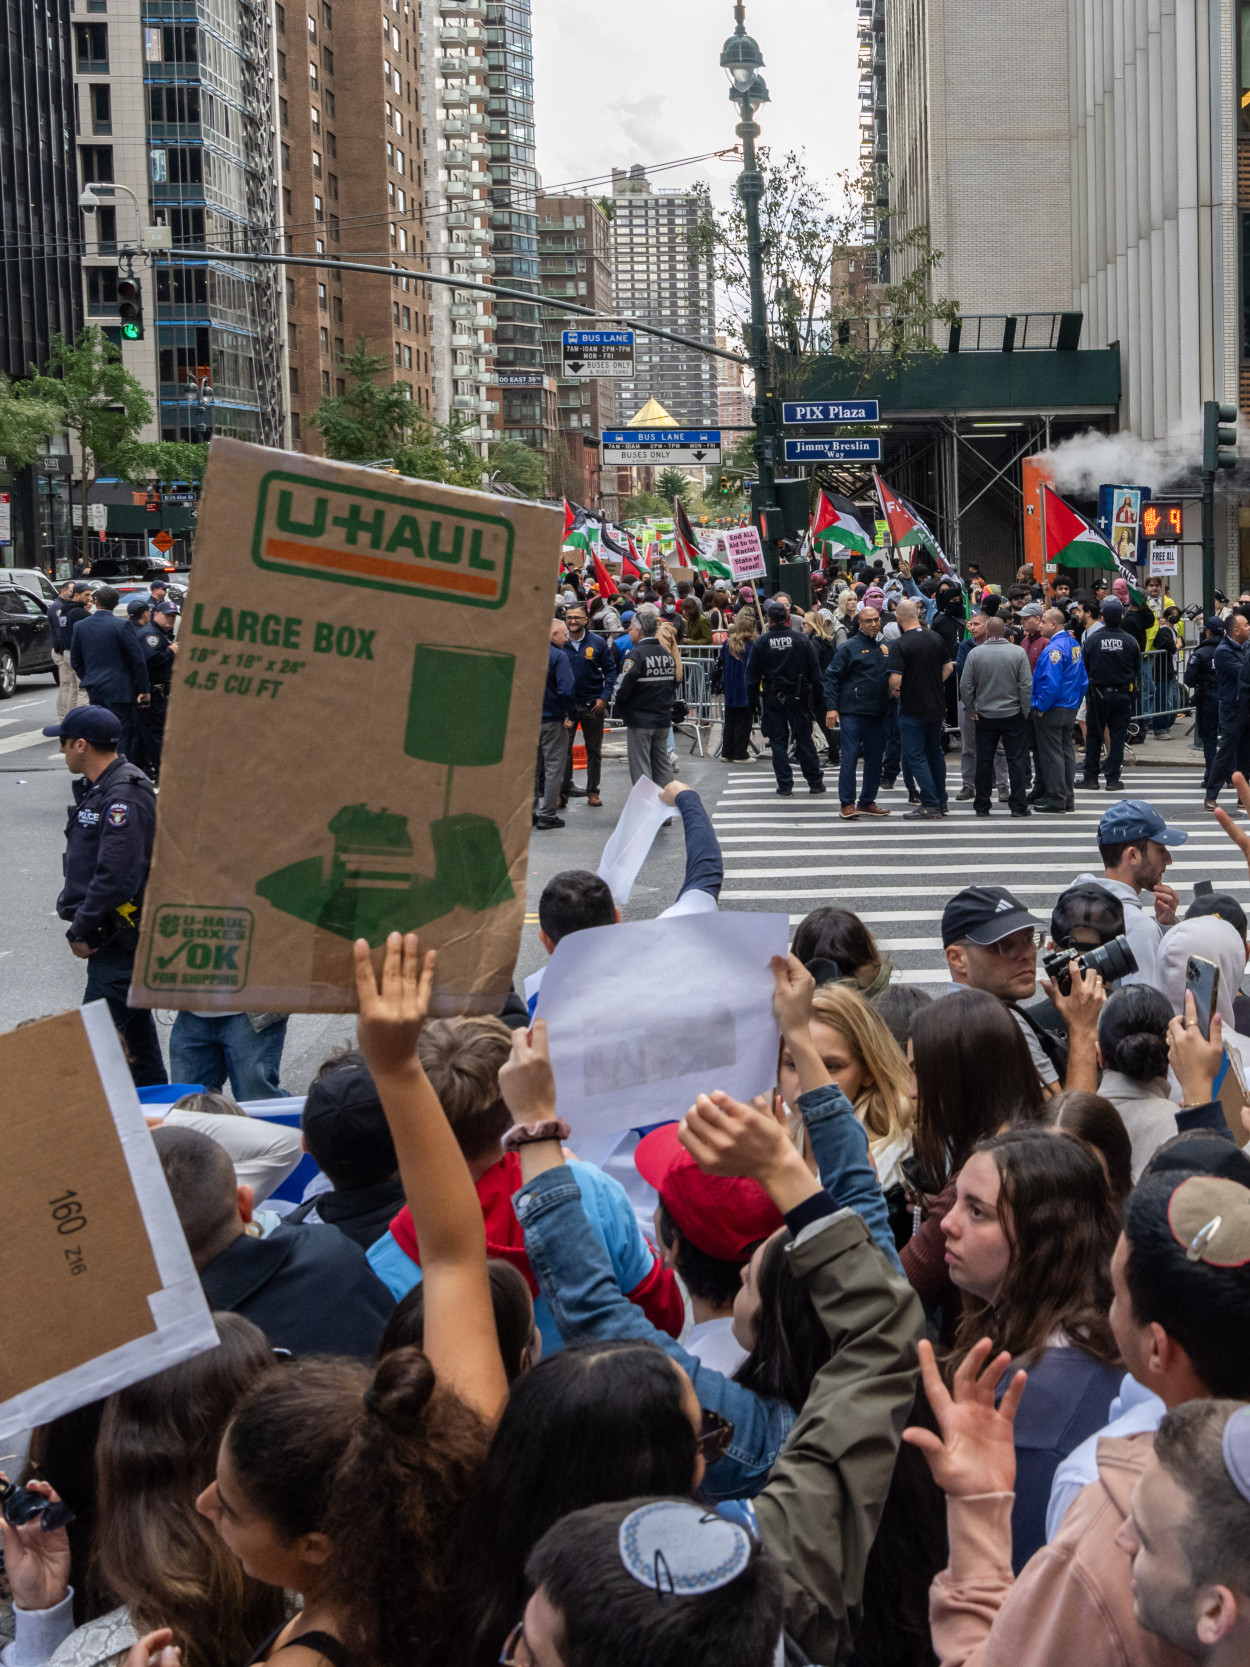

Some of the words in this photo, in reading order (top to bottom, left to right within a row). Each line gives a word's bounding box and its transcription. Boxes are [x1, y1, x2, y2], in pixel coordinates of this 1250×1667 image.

[582, 334, 601, 342] BUS
[603, 334, 629, 342] LANE
[586, 361, 610, 369] BUSES
[612, 361, 631, 369] ONLY
[795, 406, 824, 420] PIX
[828, 405, 866, 419] Plaza
[638, 433, 656, 441] BUS
[661, 433, 686, 441] LANE
[795, 442, 830, 453] Jimmy
[832, 441, 870, 451] Breslin
[621, 451, 648, 459] BUSES
[650, 451, 671, 459] ONLY
[827, 451, 845, 459] Way
[1169, 508, 1180, 534] 9
[275, 489, 497, 572] U-HAUL
[729, 533, 742, 541] End
[735, 546, 756, 555] Racist
[734, 557, 753, 565] State
[1152, 552, 1166, 561] FREE
[1166, 552, 1175, 560] ALL
[191, 602, 302, 650] LARGE
[314, 621, 378, 661] BOX
[769, 636, 792, 647] NYPD
[1101, 638, 1123, 648] NYPD
[646, 655, 675, 668] NYPD
[646, 668, 676, 676] POLICE
[184, 669, 218, 691] 4.5
[224, 673, 254, 696] CU
[256, 678, 284, 700] FT
[78, 810, 100, 822] POLICE
[181, 927, 246, 941] BOXES
[186, 942, 240, 971] OK
[152, 971, 178, 984] FOR
[181, 972, 239, 986] SHIPPING
[48, 1189, 88, 1236] 160
